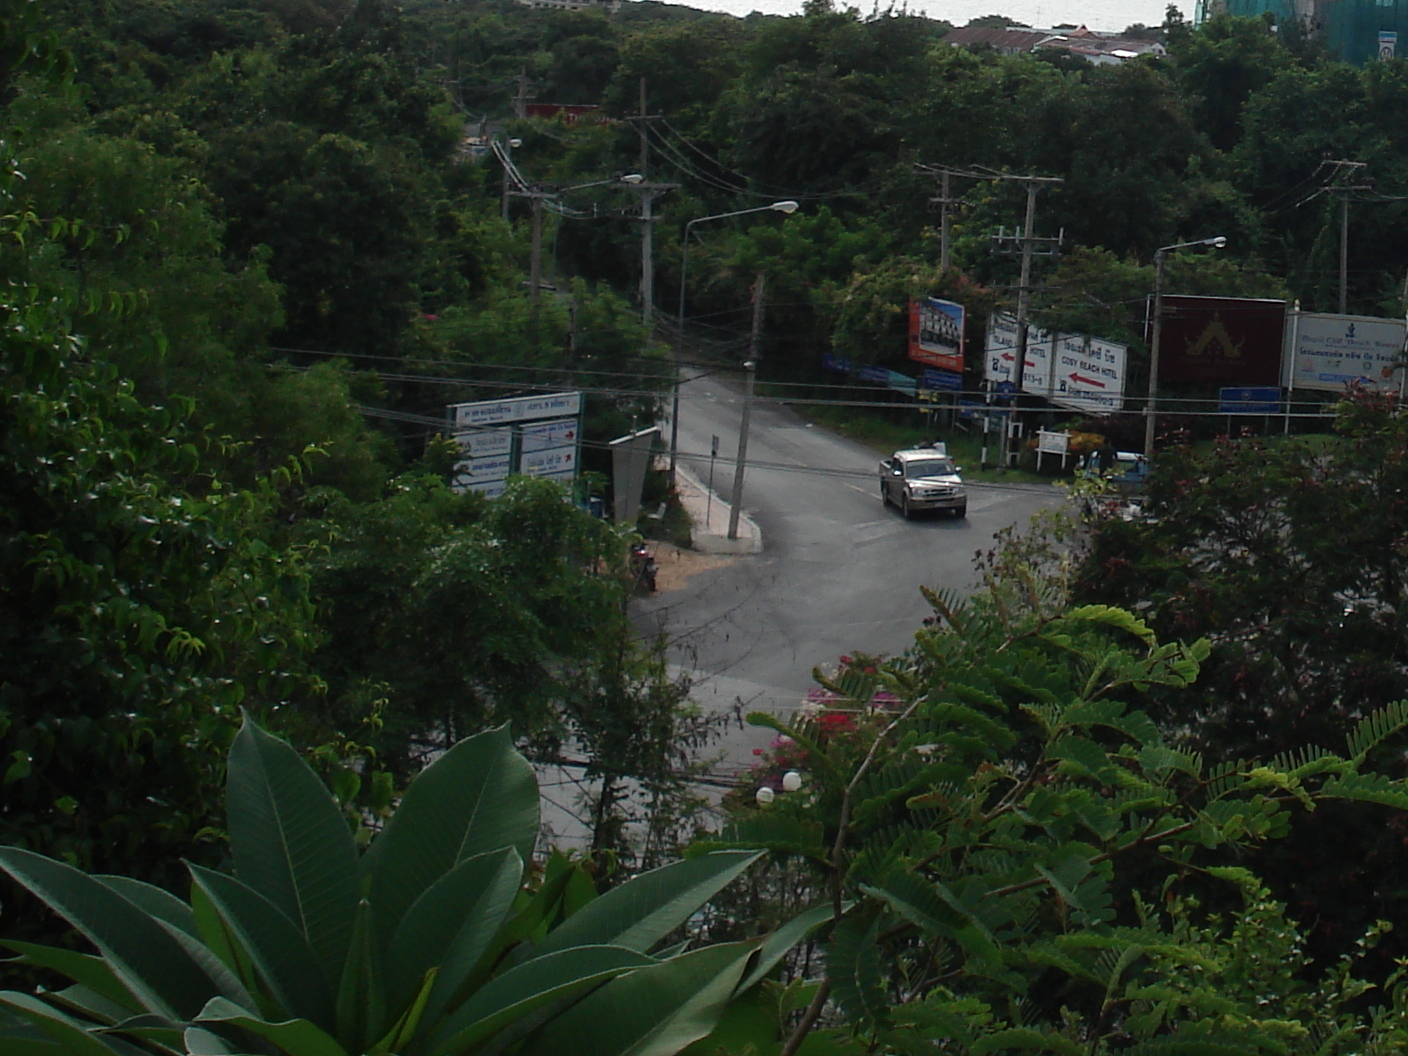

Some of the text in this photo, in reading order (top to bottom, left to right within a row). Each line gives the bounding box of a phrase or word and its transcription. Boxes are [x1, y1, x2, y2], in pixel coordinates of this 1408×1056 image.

[1062, 356, 1117, 379] COSY BEACH HOTEL
